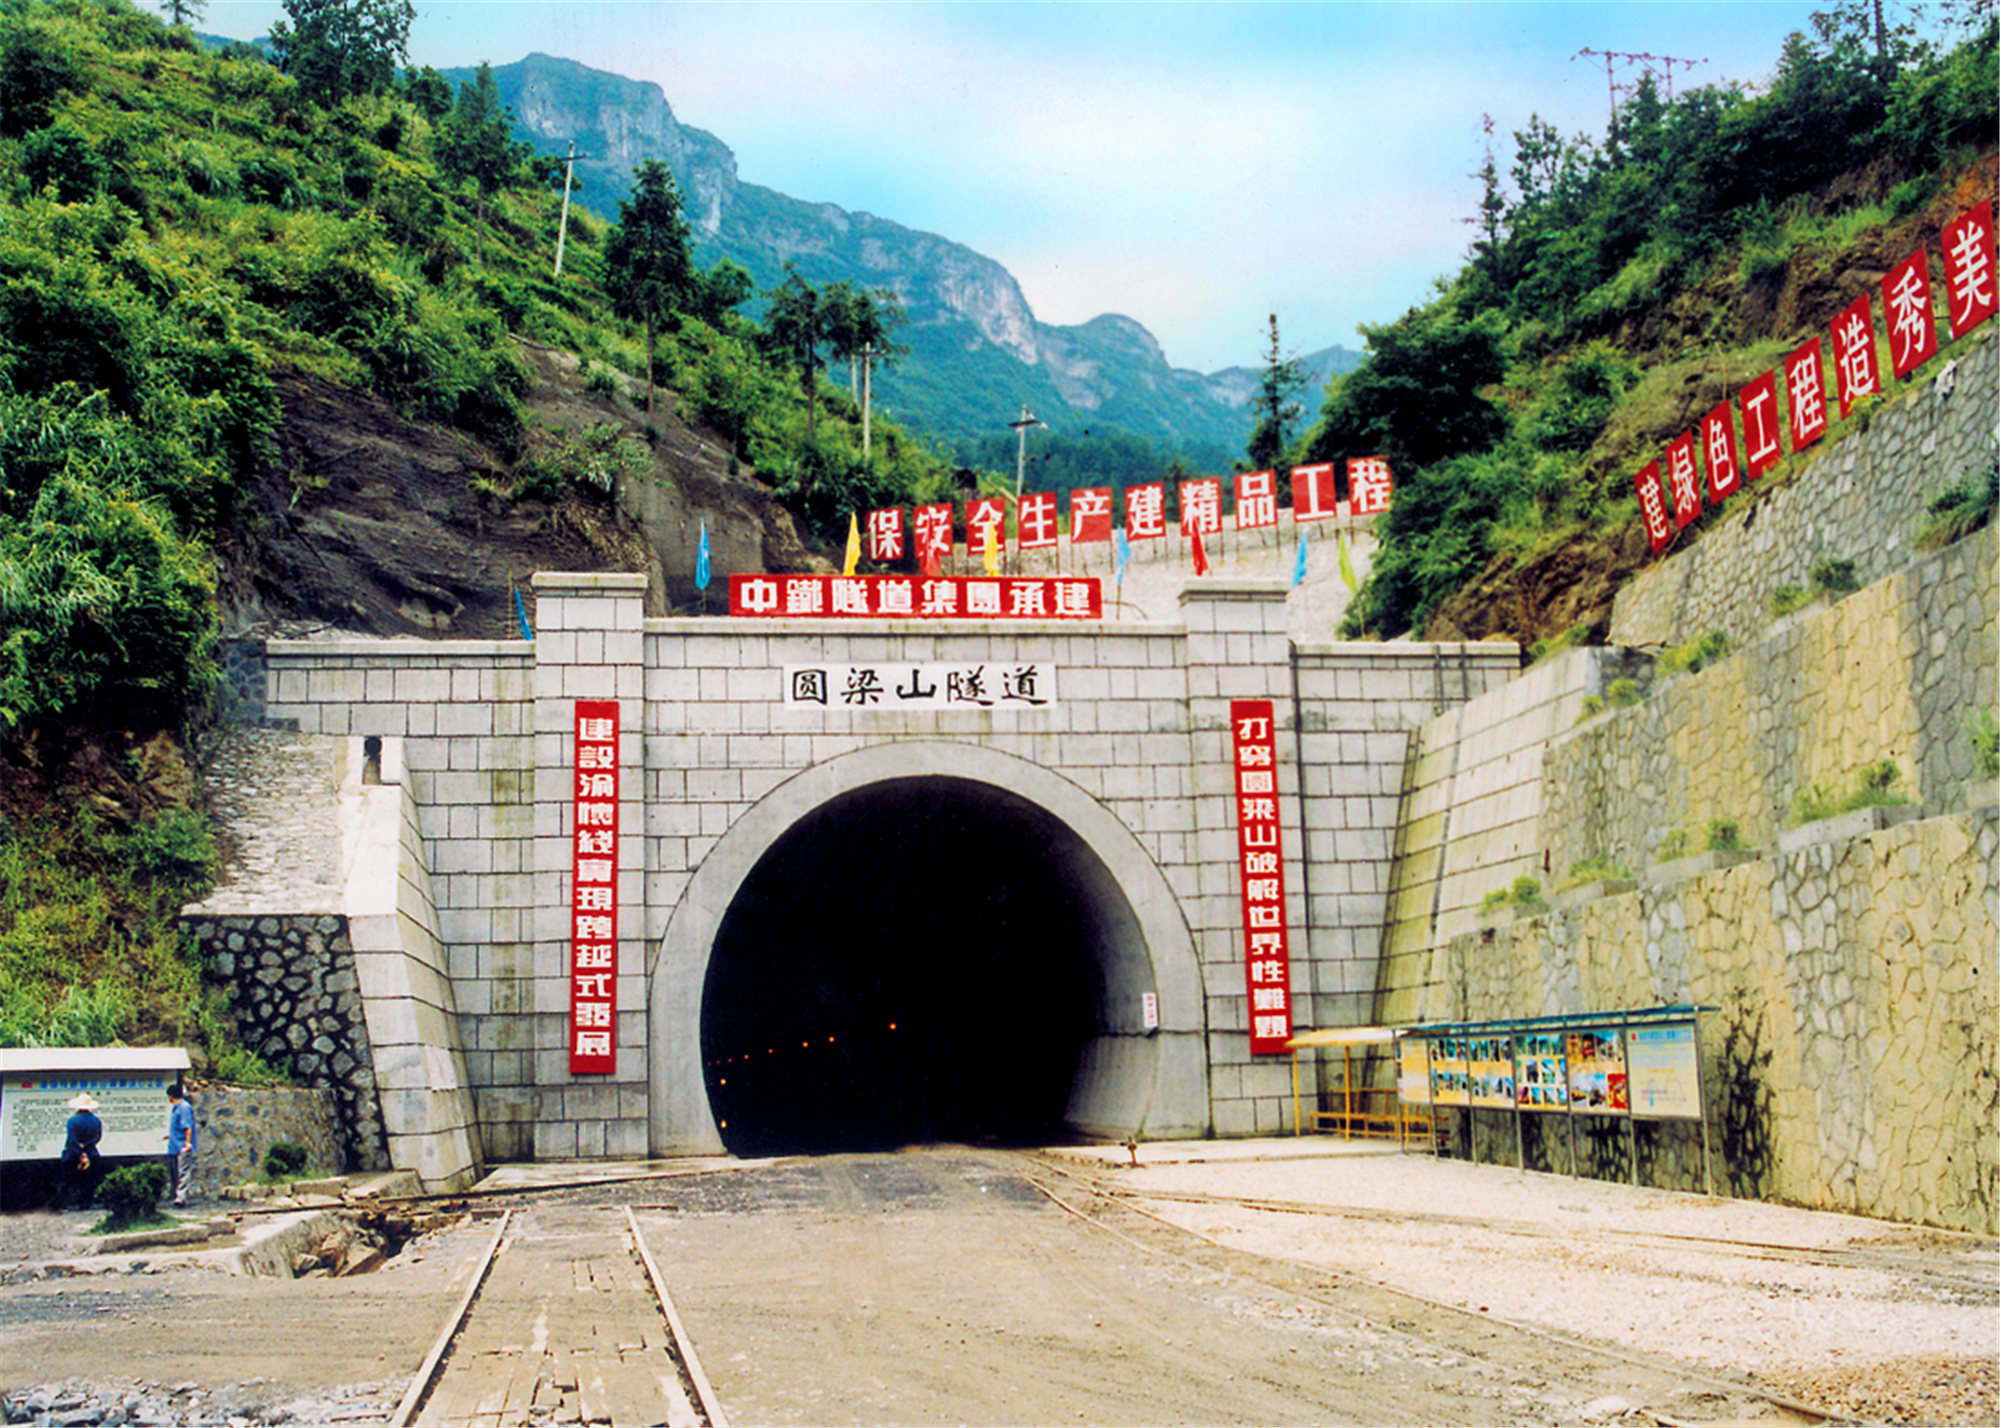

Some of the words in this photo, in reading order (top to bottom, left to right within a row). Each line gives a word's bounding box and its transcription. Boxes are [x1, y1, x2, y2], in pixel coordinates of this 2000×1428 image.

[1640, 221, 1992, 538] 建绿色工程造秀美
[867, 457, 1391, 560] 保安全生产建精品工程
[792, 665, 1048, 706] 圆梁山隧道
